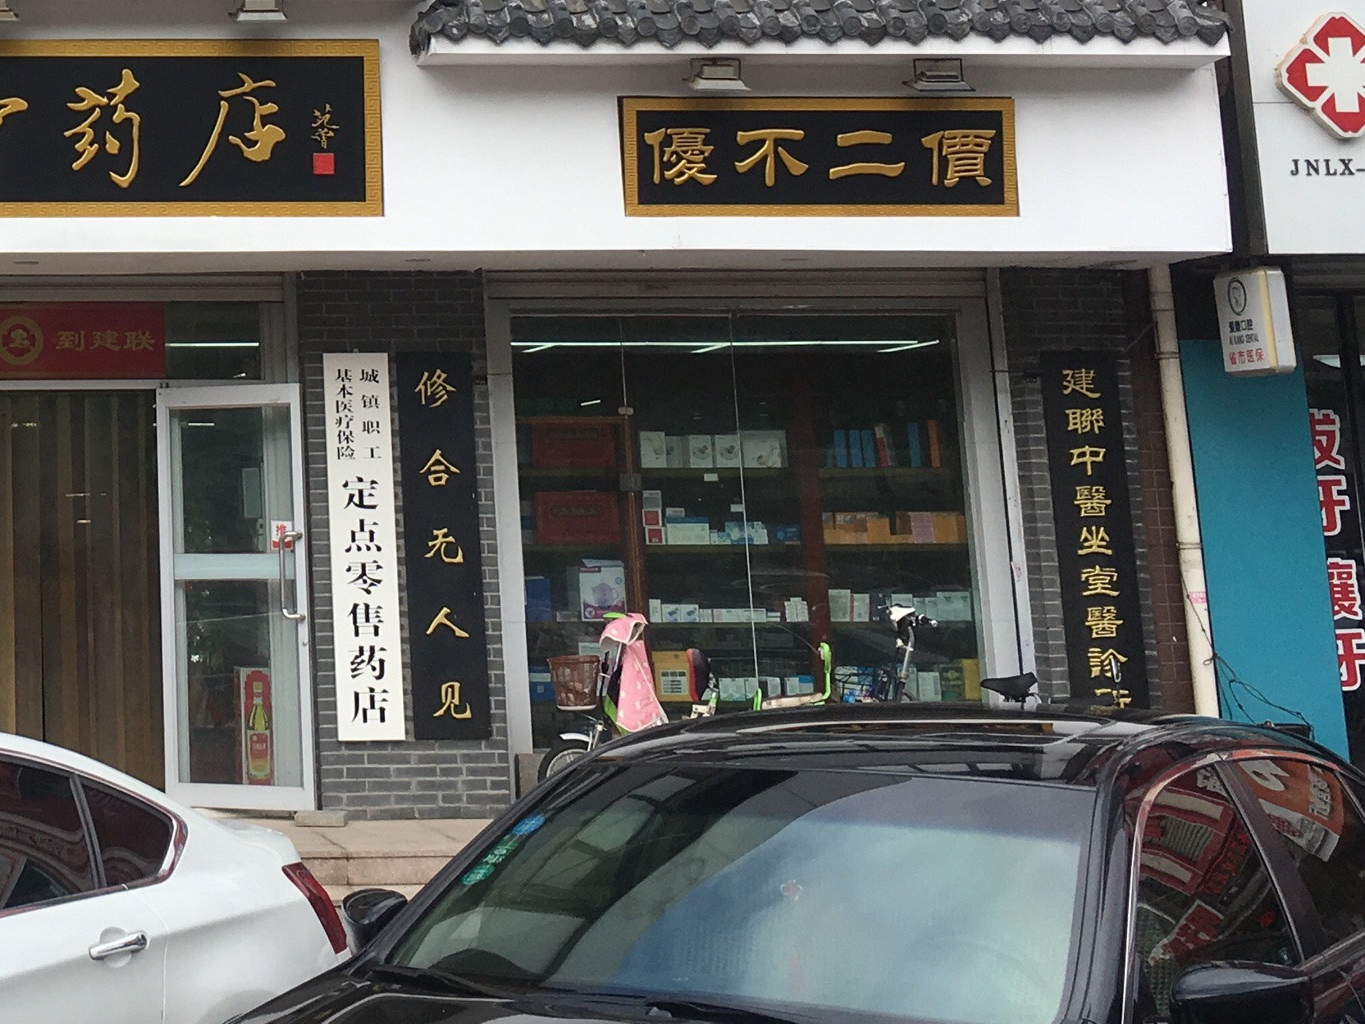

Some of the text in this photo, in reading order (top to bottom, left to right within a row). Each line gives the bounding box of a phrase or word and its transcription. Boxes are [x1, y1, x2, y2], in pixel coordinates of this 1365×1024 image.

[644, 127, 997, 188] 優不二價
[55, 330, 156, 352] 到建联
[335, 367, 356, 461] 基本医疗保险
[358, 367, 383, 460] 城镇职工
[414, 368, 472, 720] 修合无人见
[341, 475, 389, 725] 定点零售药店
